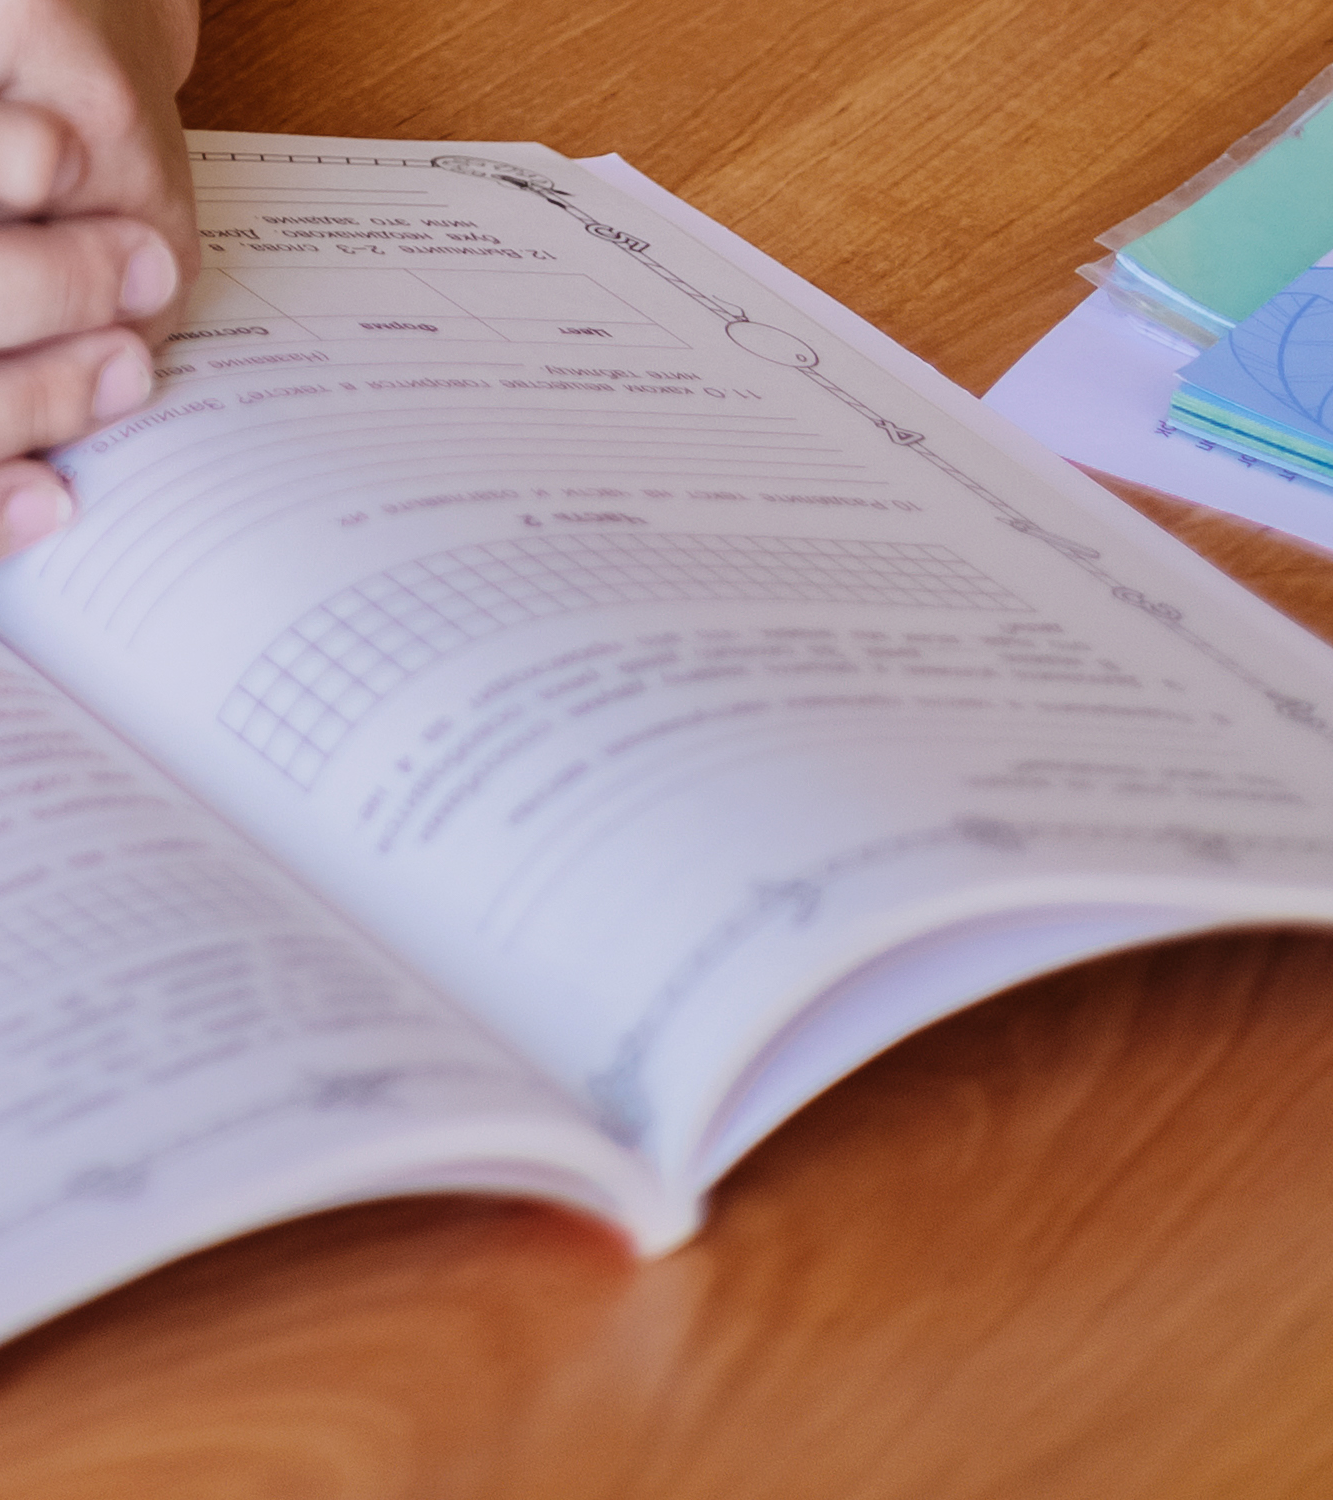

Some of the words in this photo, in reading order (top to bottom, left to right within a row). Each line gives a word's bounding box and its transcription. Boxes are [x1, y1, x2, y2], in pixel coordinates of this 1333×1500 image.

[368, 217, 412, 227] это
[420, 218, 479, 230] нили
[273, 229, 435, 242] неодинаково.
[444, 232, 502, 246] букв
[207, 243, 227, 253] в
[238, 242, 321, 254] слова,
[356, 320, 439, 334] Форма
[556, 325, 614, 339] Цвет
[644, 370, 702, 382] ните
[337, 381, 358, 391] в
[364, 376, 492, 393] говорится
[499, 379, 617, 393] веществе
[622, 383, 695, 396] каком
[237, 383, 333, 405] тексте?
[81, 397, 228, 456] Запишите.
